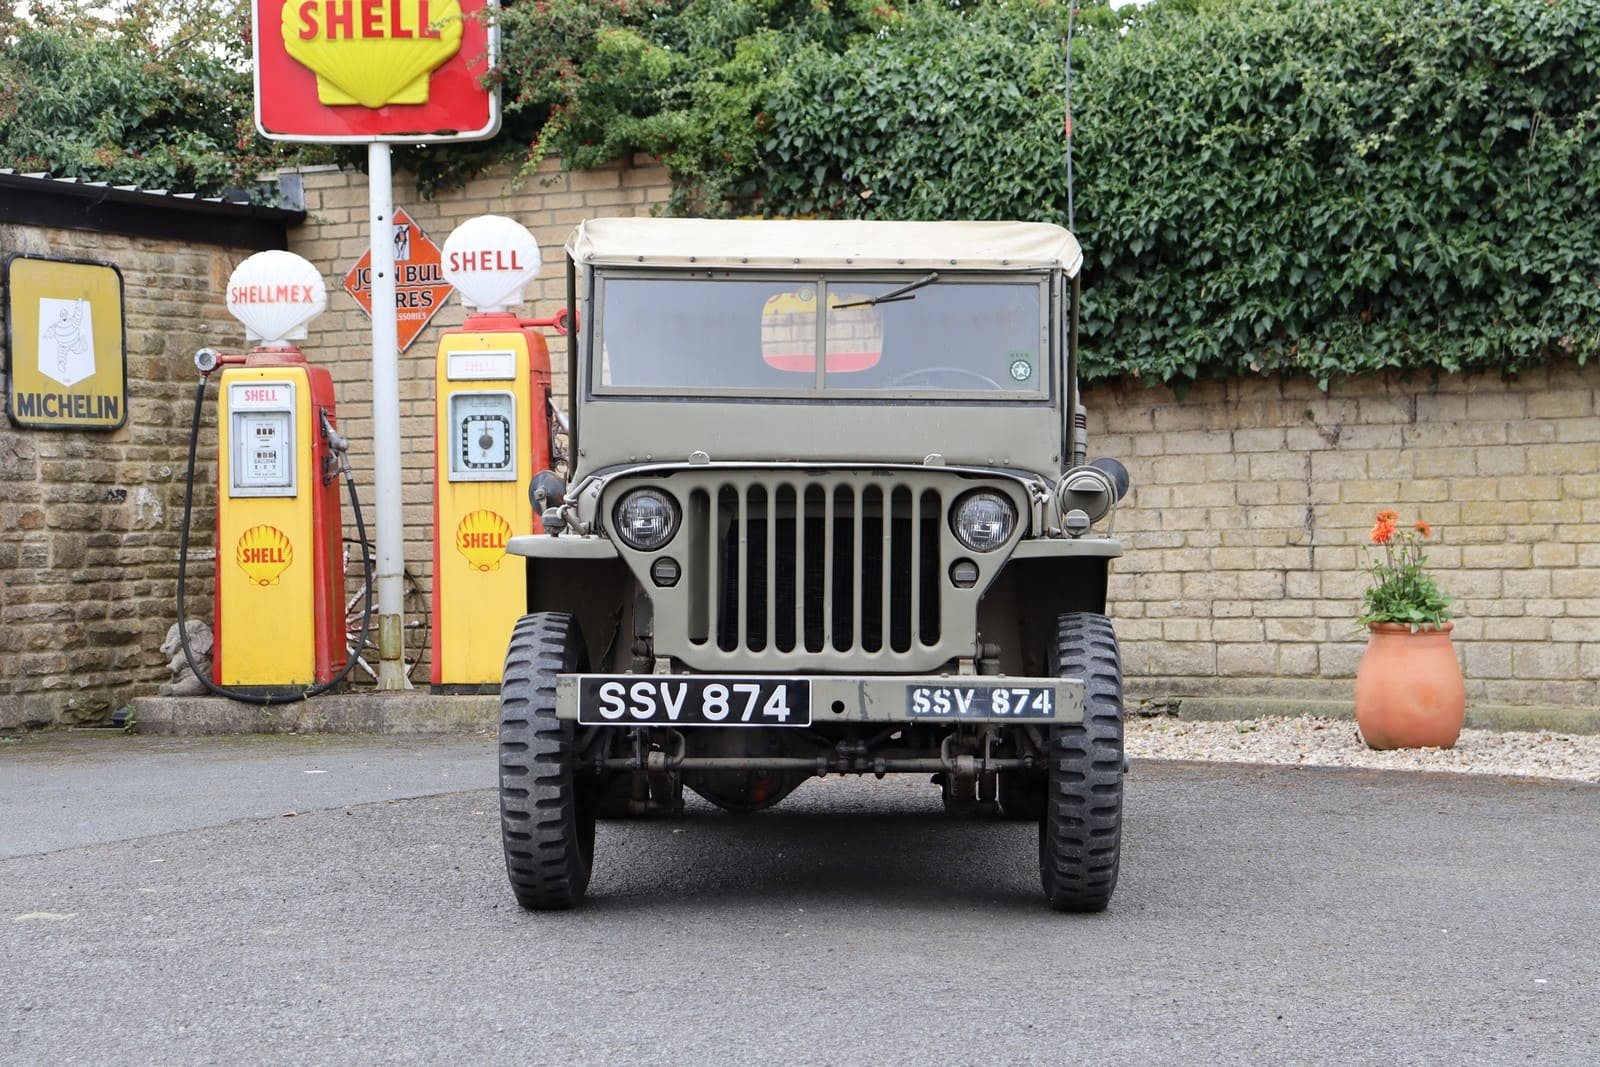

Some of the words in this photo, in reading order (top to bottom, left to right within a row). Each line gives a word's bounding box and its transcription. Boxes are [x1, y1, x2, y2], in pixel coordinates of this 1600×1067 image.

[298, 0, 441, 41] SHELL
[450, 250, 524, 272] SHELL
[353, 267, 400, 291] JO
[406, 264, 445, 282] BUL
[231, 284, 314, 304] SHELLMEX
[17, 392, 118, 419] MICHELIN
[244, 389, 278, 402] SHELL
[462, 532, 505, 549] SHELL
[243, 547, 285, 564] SHELL
[599, 682, 688, 720] SSV
[702, 683, 791, 721] 874
[912, 687, 976, 714] SSV
[991, 687, 1052, 714] 874
